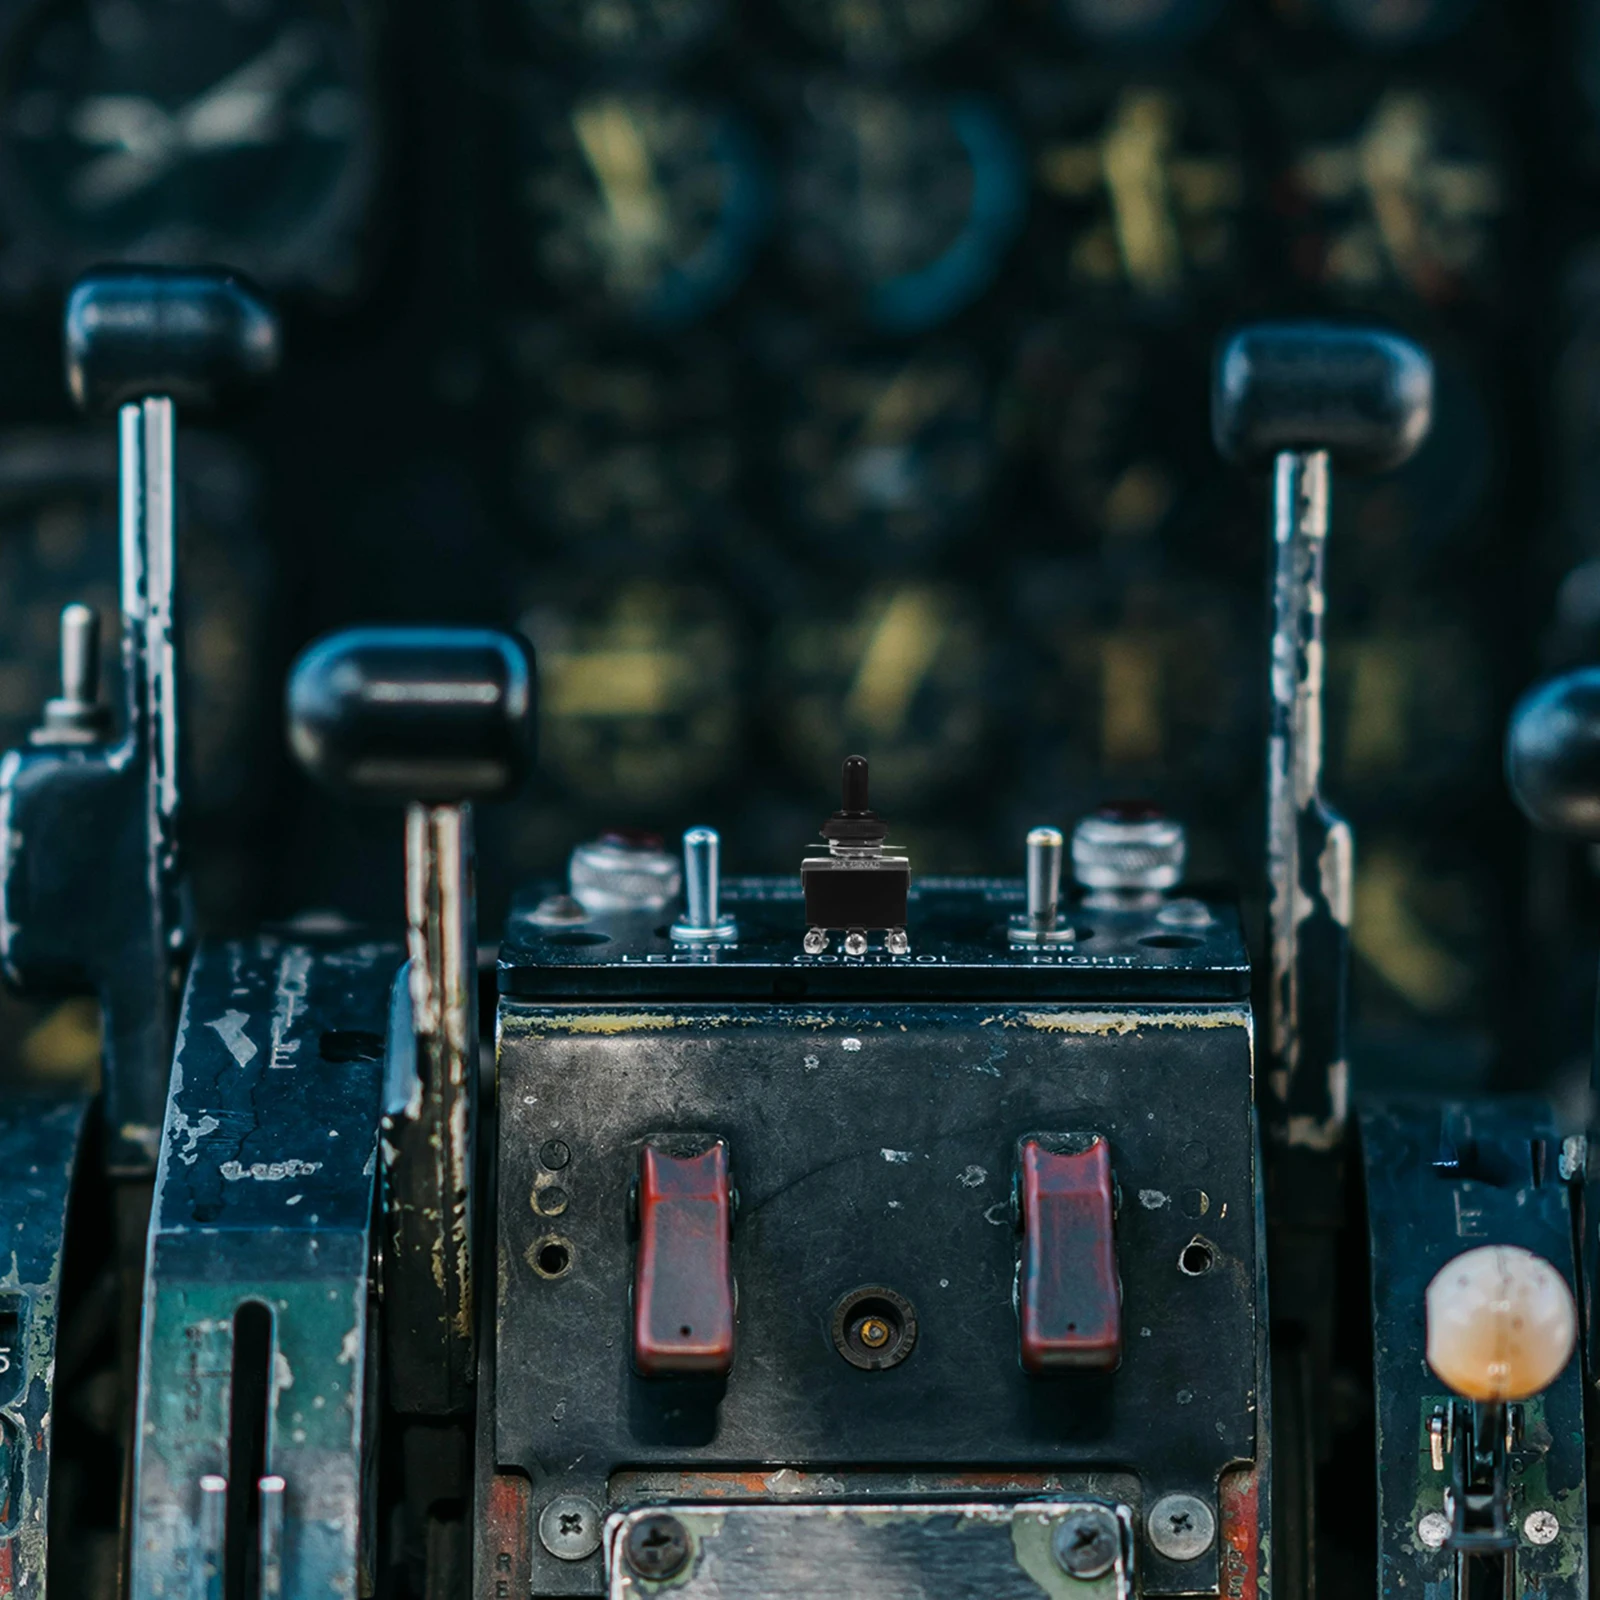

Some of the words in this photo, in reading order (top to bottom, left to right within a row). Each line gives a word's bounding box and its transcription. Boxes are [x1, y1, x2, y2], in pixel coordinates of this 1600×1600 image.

[621, 954, 715, 963] LEFT
[793, 954, 957, 963] CONTROL
[1032, 955, 1137, 964] RIGHT
